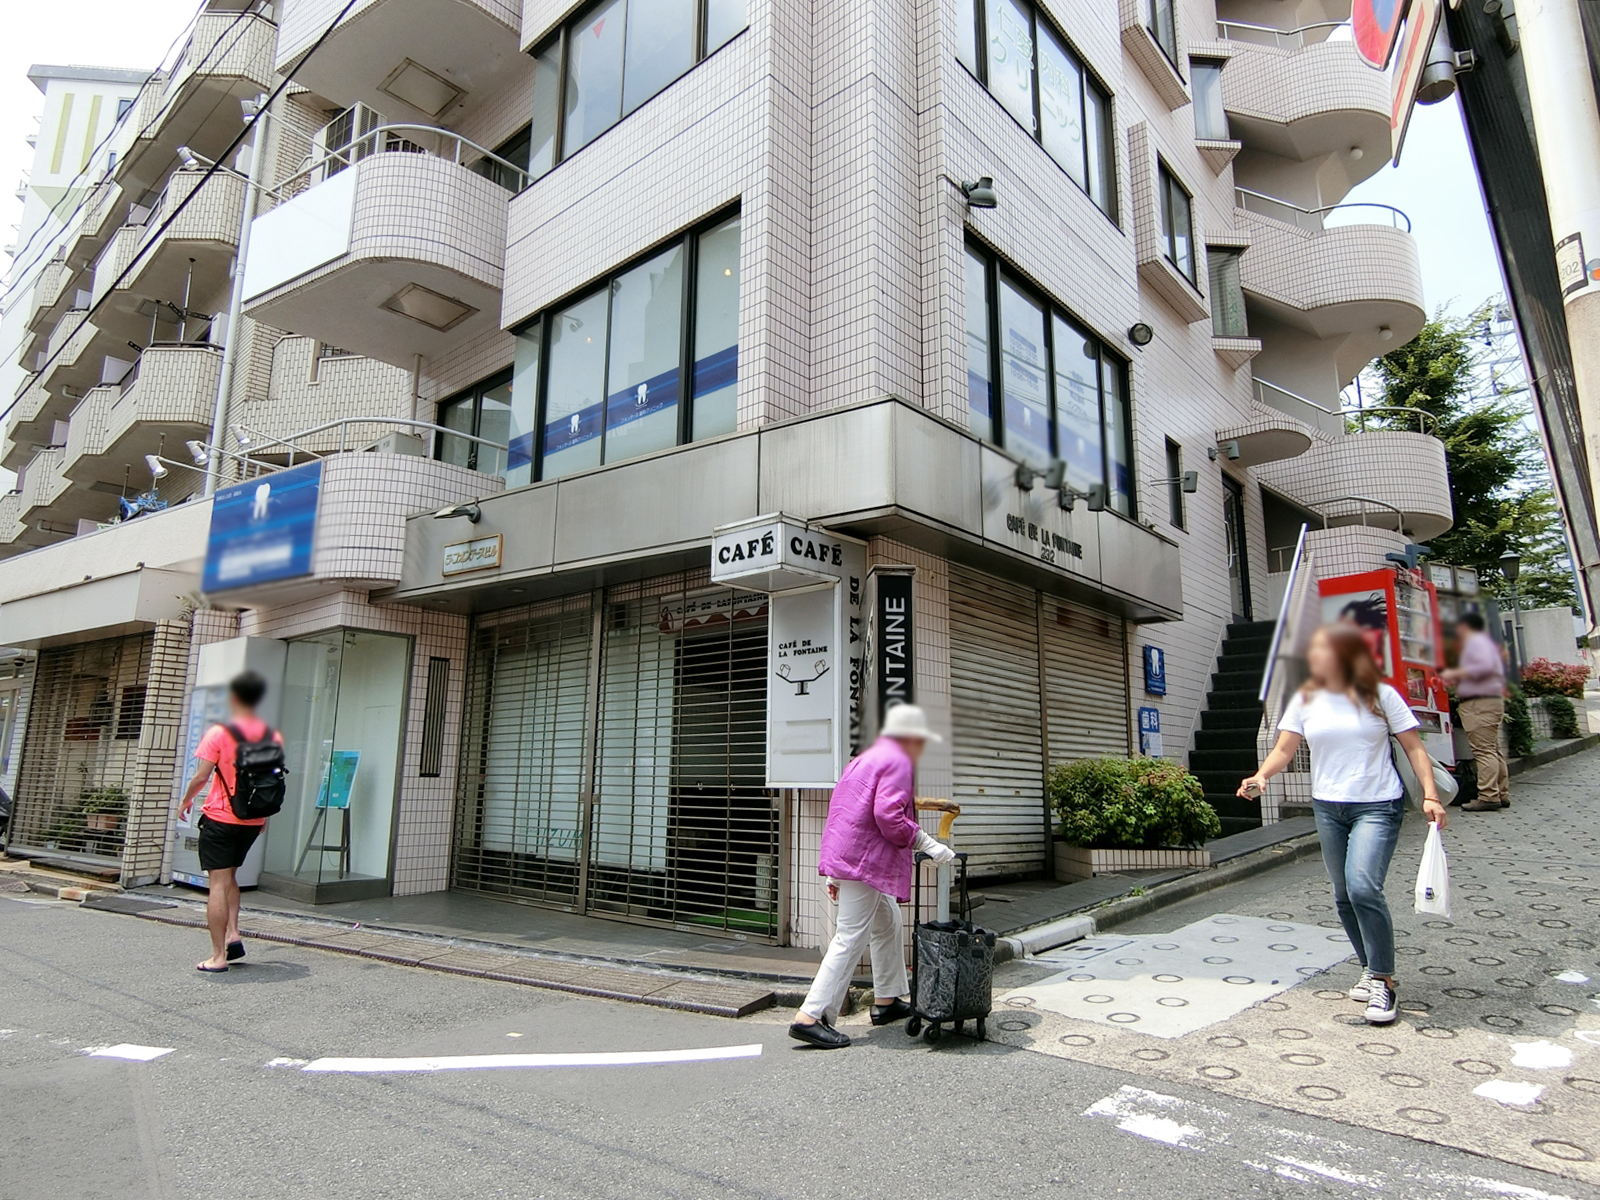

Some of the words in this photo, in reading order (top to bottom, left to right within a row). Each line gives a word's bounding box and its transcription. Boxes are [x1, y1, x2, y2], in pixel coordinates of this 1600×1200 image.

[718, 530, 774, 564] CAFÉ
[1041, 528, 1050, 548] LA
[790, 535, 842, 567] CAFÉ
[1040, 546, 1055, 563] 232
[850, 576, 859, 605] DE
[850, 616, 859, 644] LA
[778, 639, 797, 650] CAFÉ
[802, 639, 811, 647] DE
[793, 645, 828, 656] FONTAINE
[850, 657, 859, 758] FONTAIN
[1142, 710, 1158, 729] 歯科
